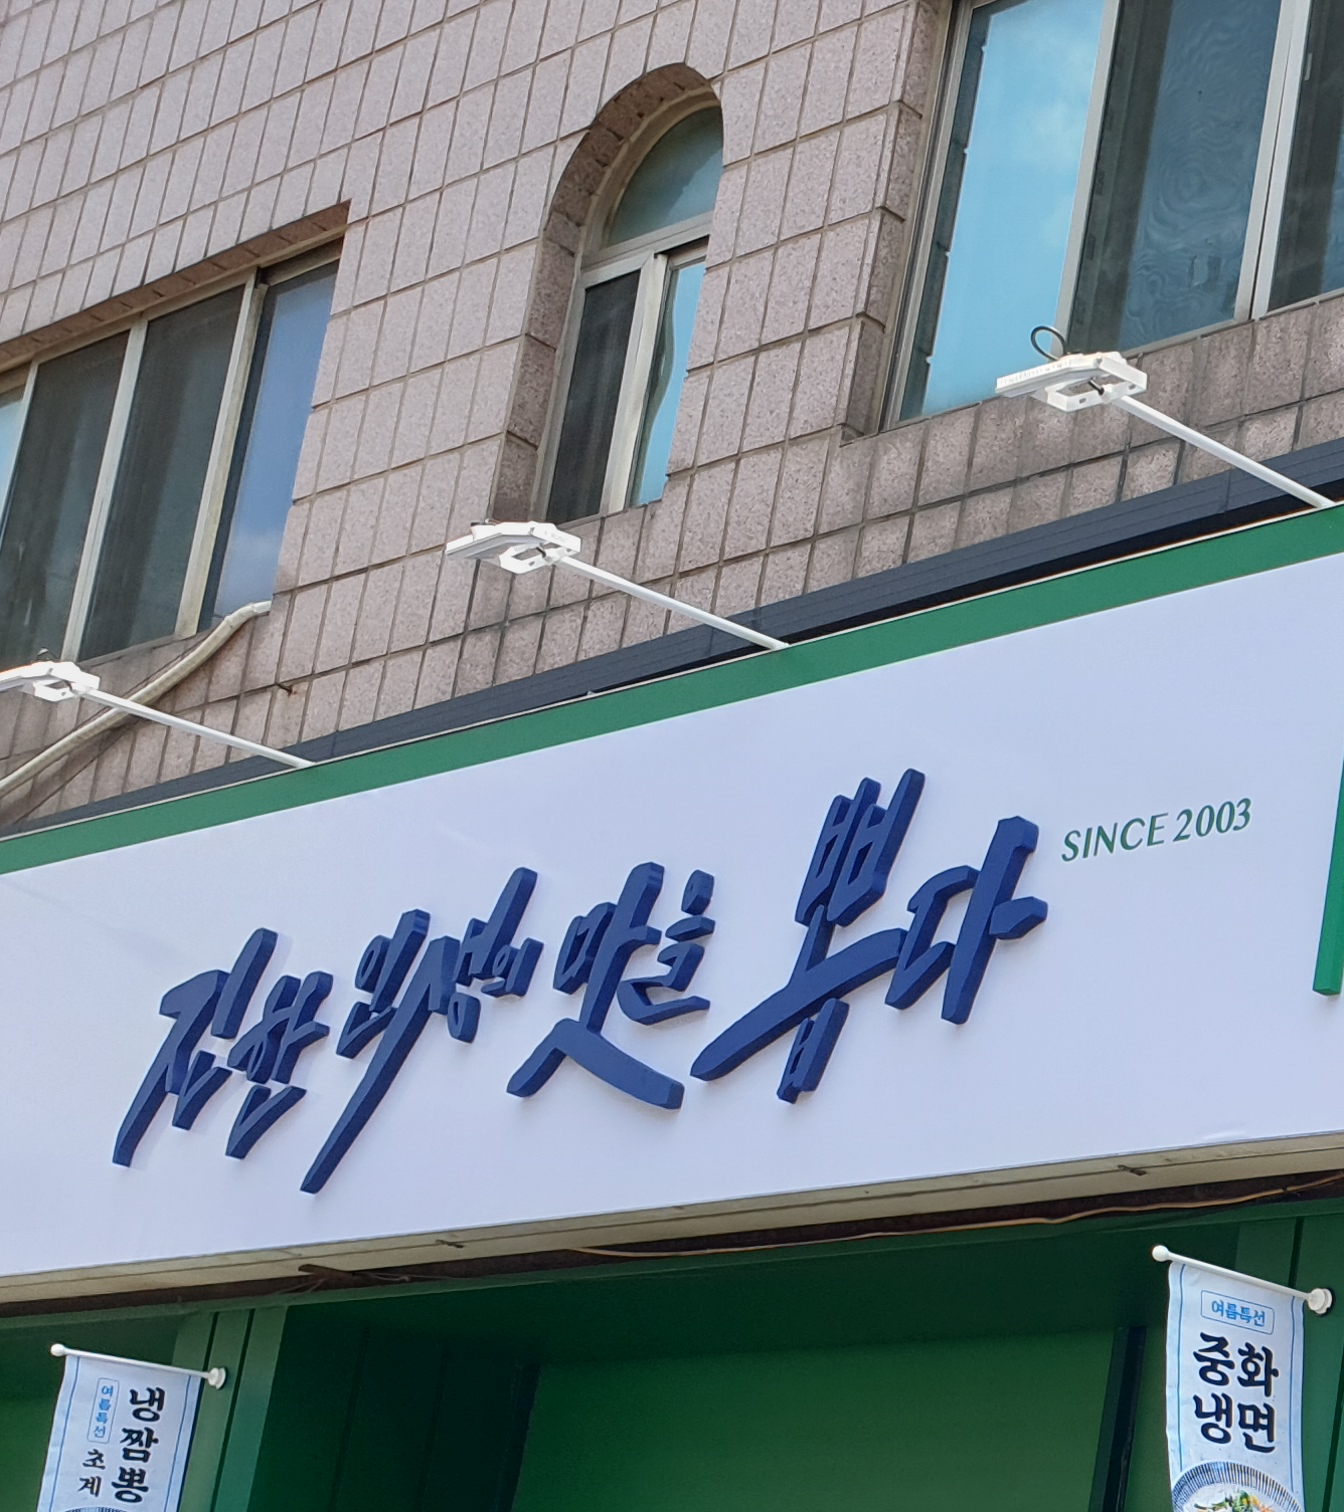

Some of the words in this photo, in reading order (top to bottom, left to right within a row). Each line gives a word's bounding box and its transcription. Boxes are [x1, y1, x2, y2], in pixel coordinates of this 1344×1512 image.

[1061, 813, 1169, 862] SINCE
[1172, 797, 1253, 843] 2003
[112, 927, 334, 1168] 진한
[506, 862, 716, 1111] 맛을
[1211, 1299, 1266, 1327] 여름특선
[1193, 1331, 1279, 1398] 중화
[111, 1386, 166, 1503] 냉짬뽕
[1193, 1392, 1276, 1453] 냉면
[78, 1448, 106, 1498] 초계
